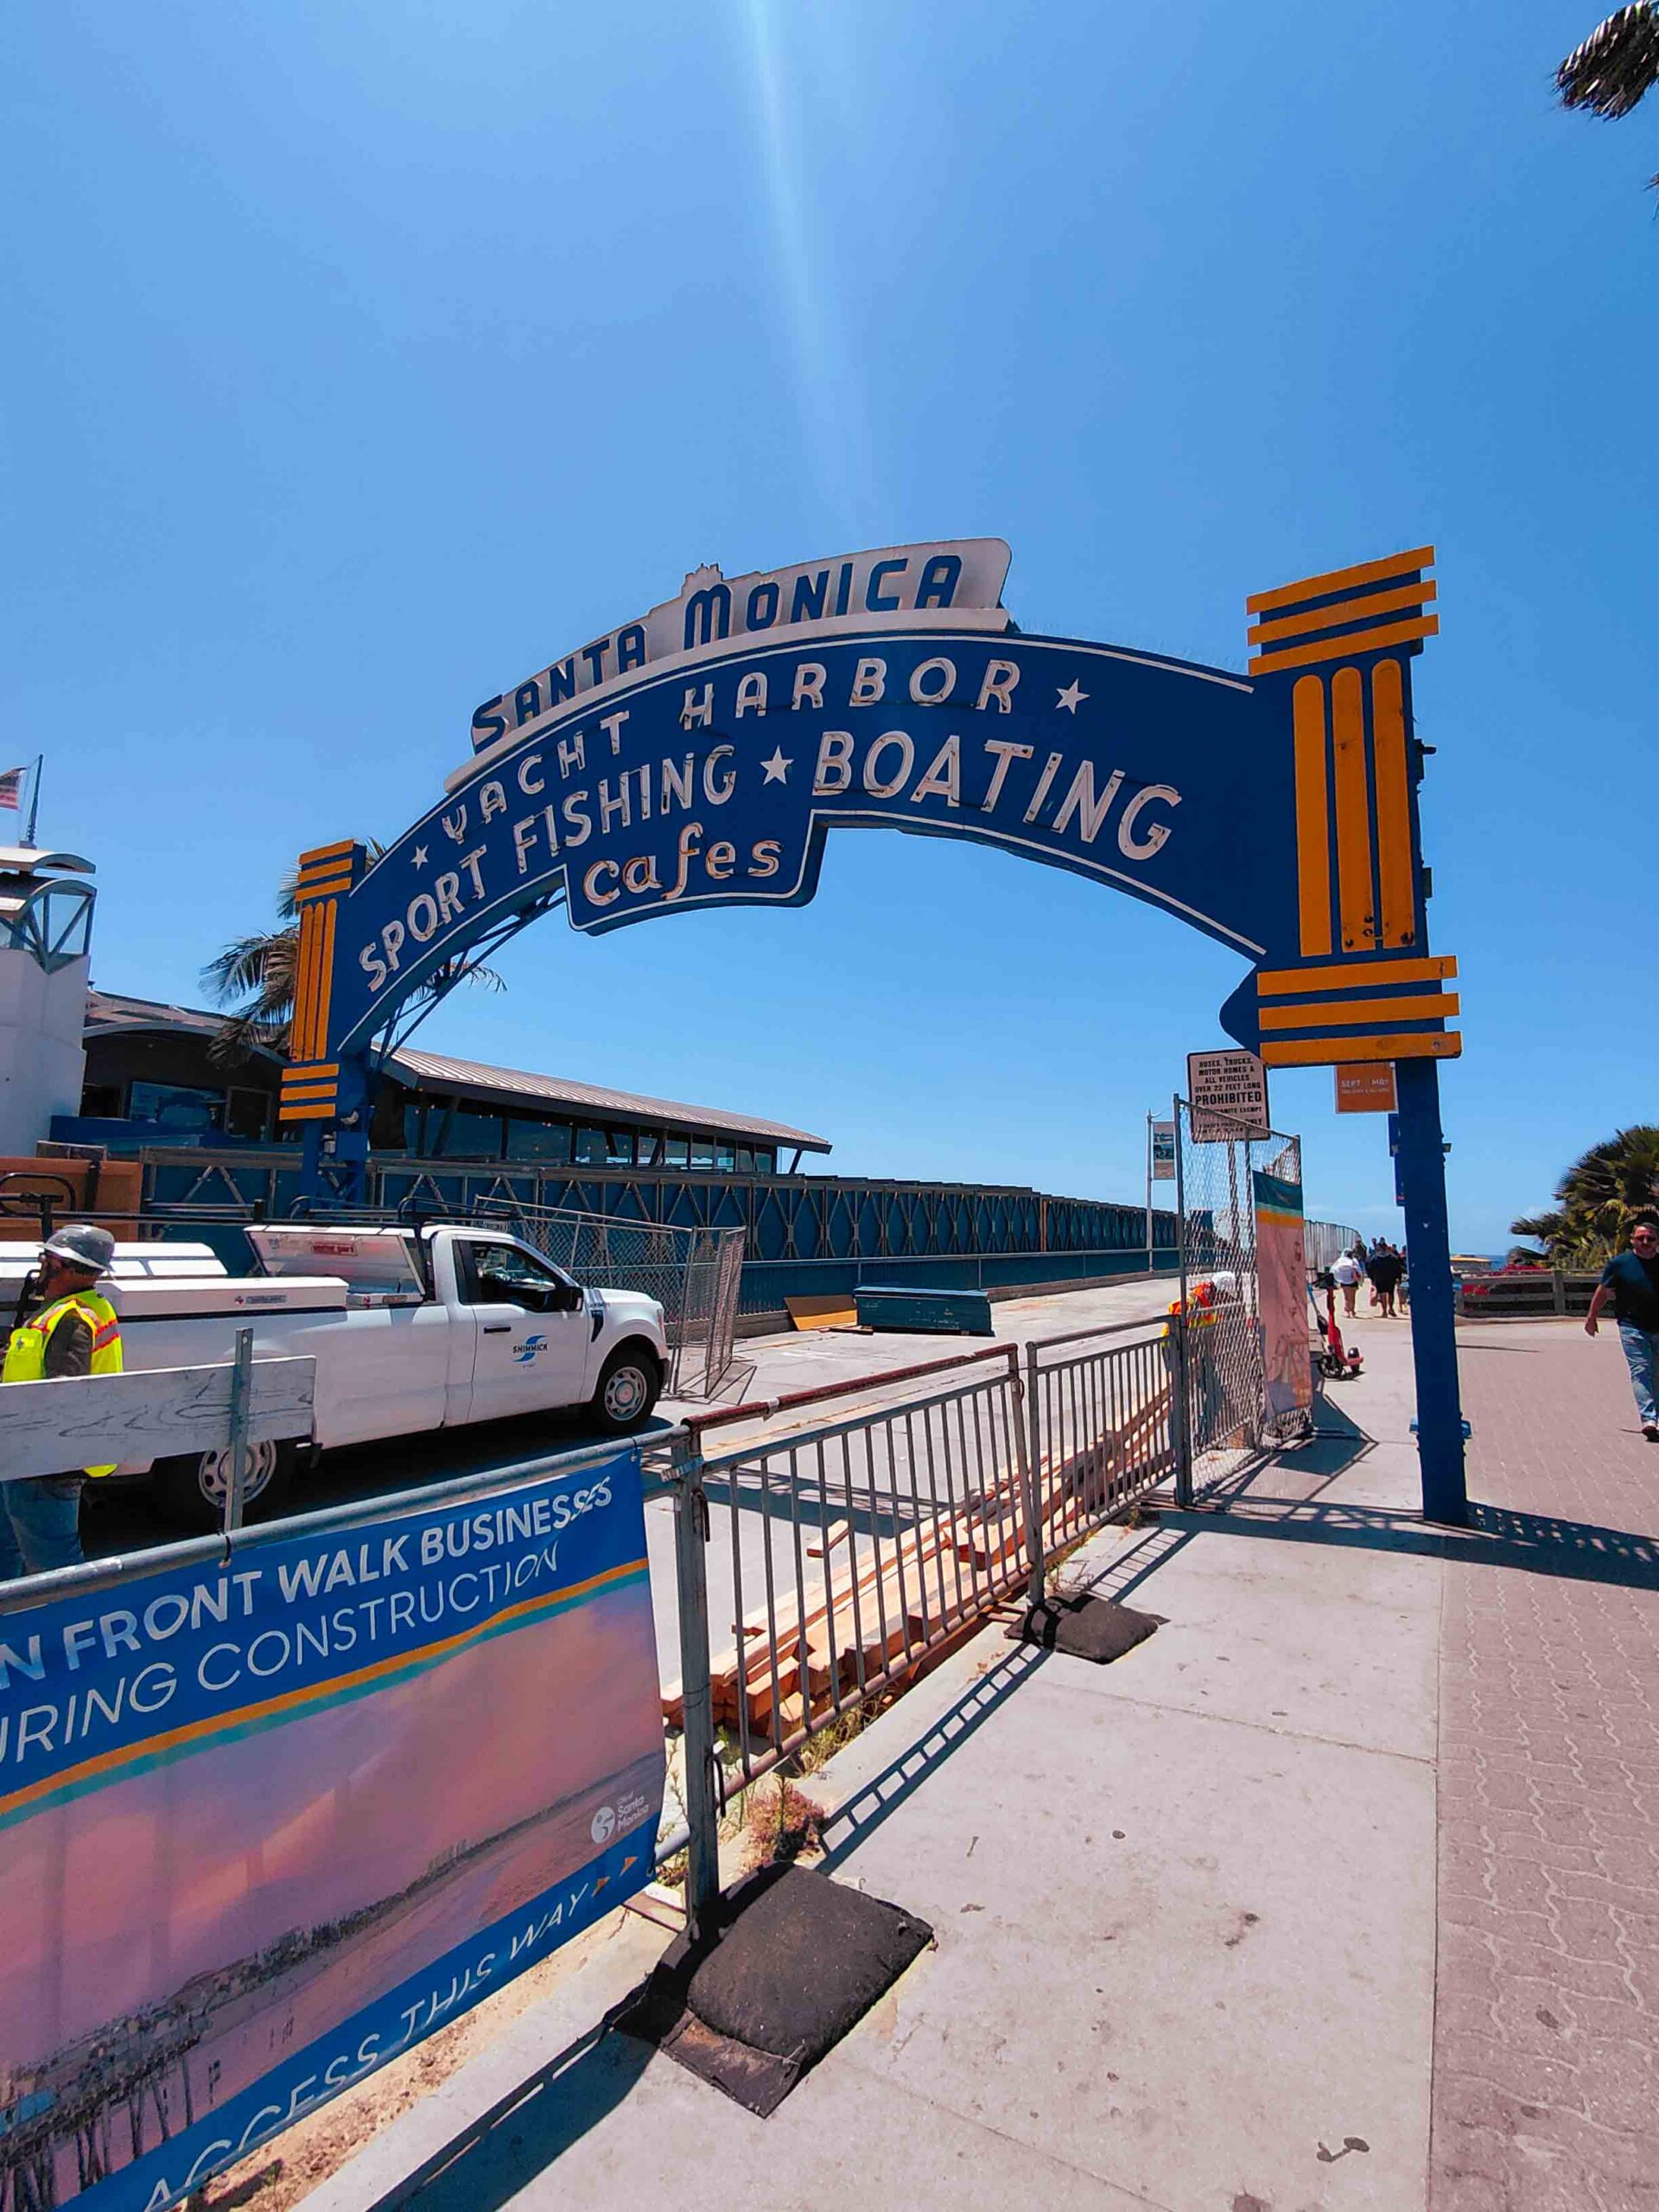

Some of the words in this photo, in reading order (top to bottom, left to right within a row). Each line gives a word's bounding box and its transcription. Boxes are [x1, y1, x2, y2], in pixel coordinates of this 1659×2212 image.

[472, 624, 648, 754] SANTA
[683, 554, 963, 651] MONICA
[441, 709, 630, 844] YACHT
[680, 657, 1021, 732] HARBOR
[359, 844, 487, 992] SPORT
[512, 744, 737, 874] FISHING
[812, 730, 1183, 861] BOATING
[1195, 1091, 1262, 1105] PROHIBITED
[1198, 1068, 1221, 1077] MOTOR
[1224, 1065, 1247, 1074] HOMES
[1219, 1074, 1250, 1083] VEHICLES
[512, 1343, 548, 1353] SHIMMICK
[63, 1571, 262, 1670] FRONT
[278, 1534, 410, 1603] WALK
[421, 1476, 613, 1566] BUSINESSES
[0, 1662, 176, 1763] RING
[197, 1542, 558, 1690] CONSTRUCTION
[618, 1796, 645, 1818] Santa
[401, 1953, 496, 2041] THIS
[510, 1883, 589, 1963] WAY
